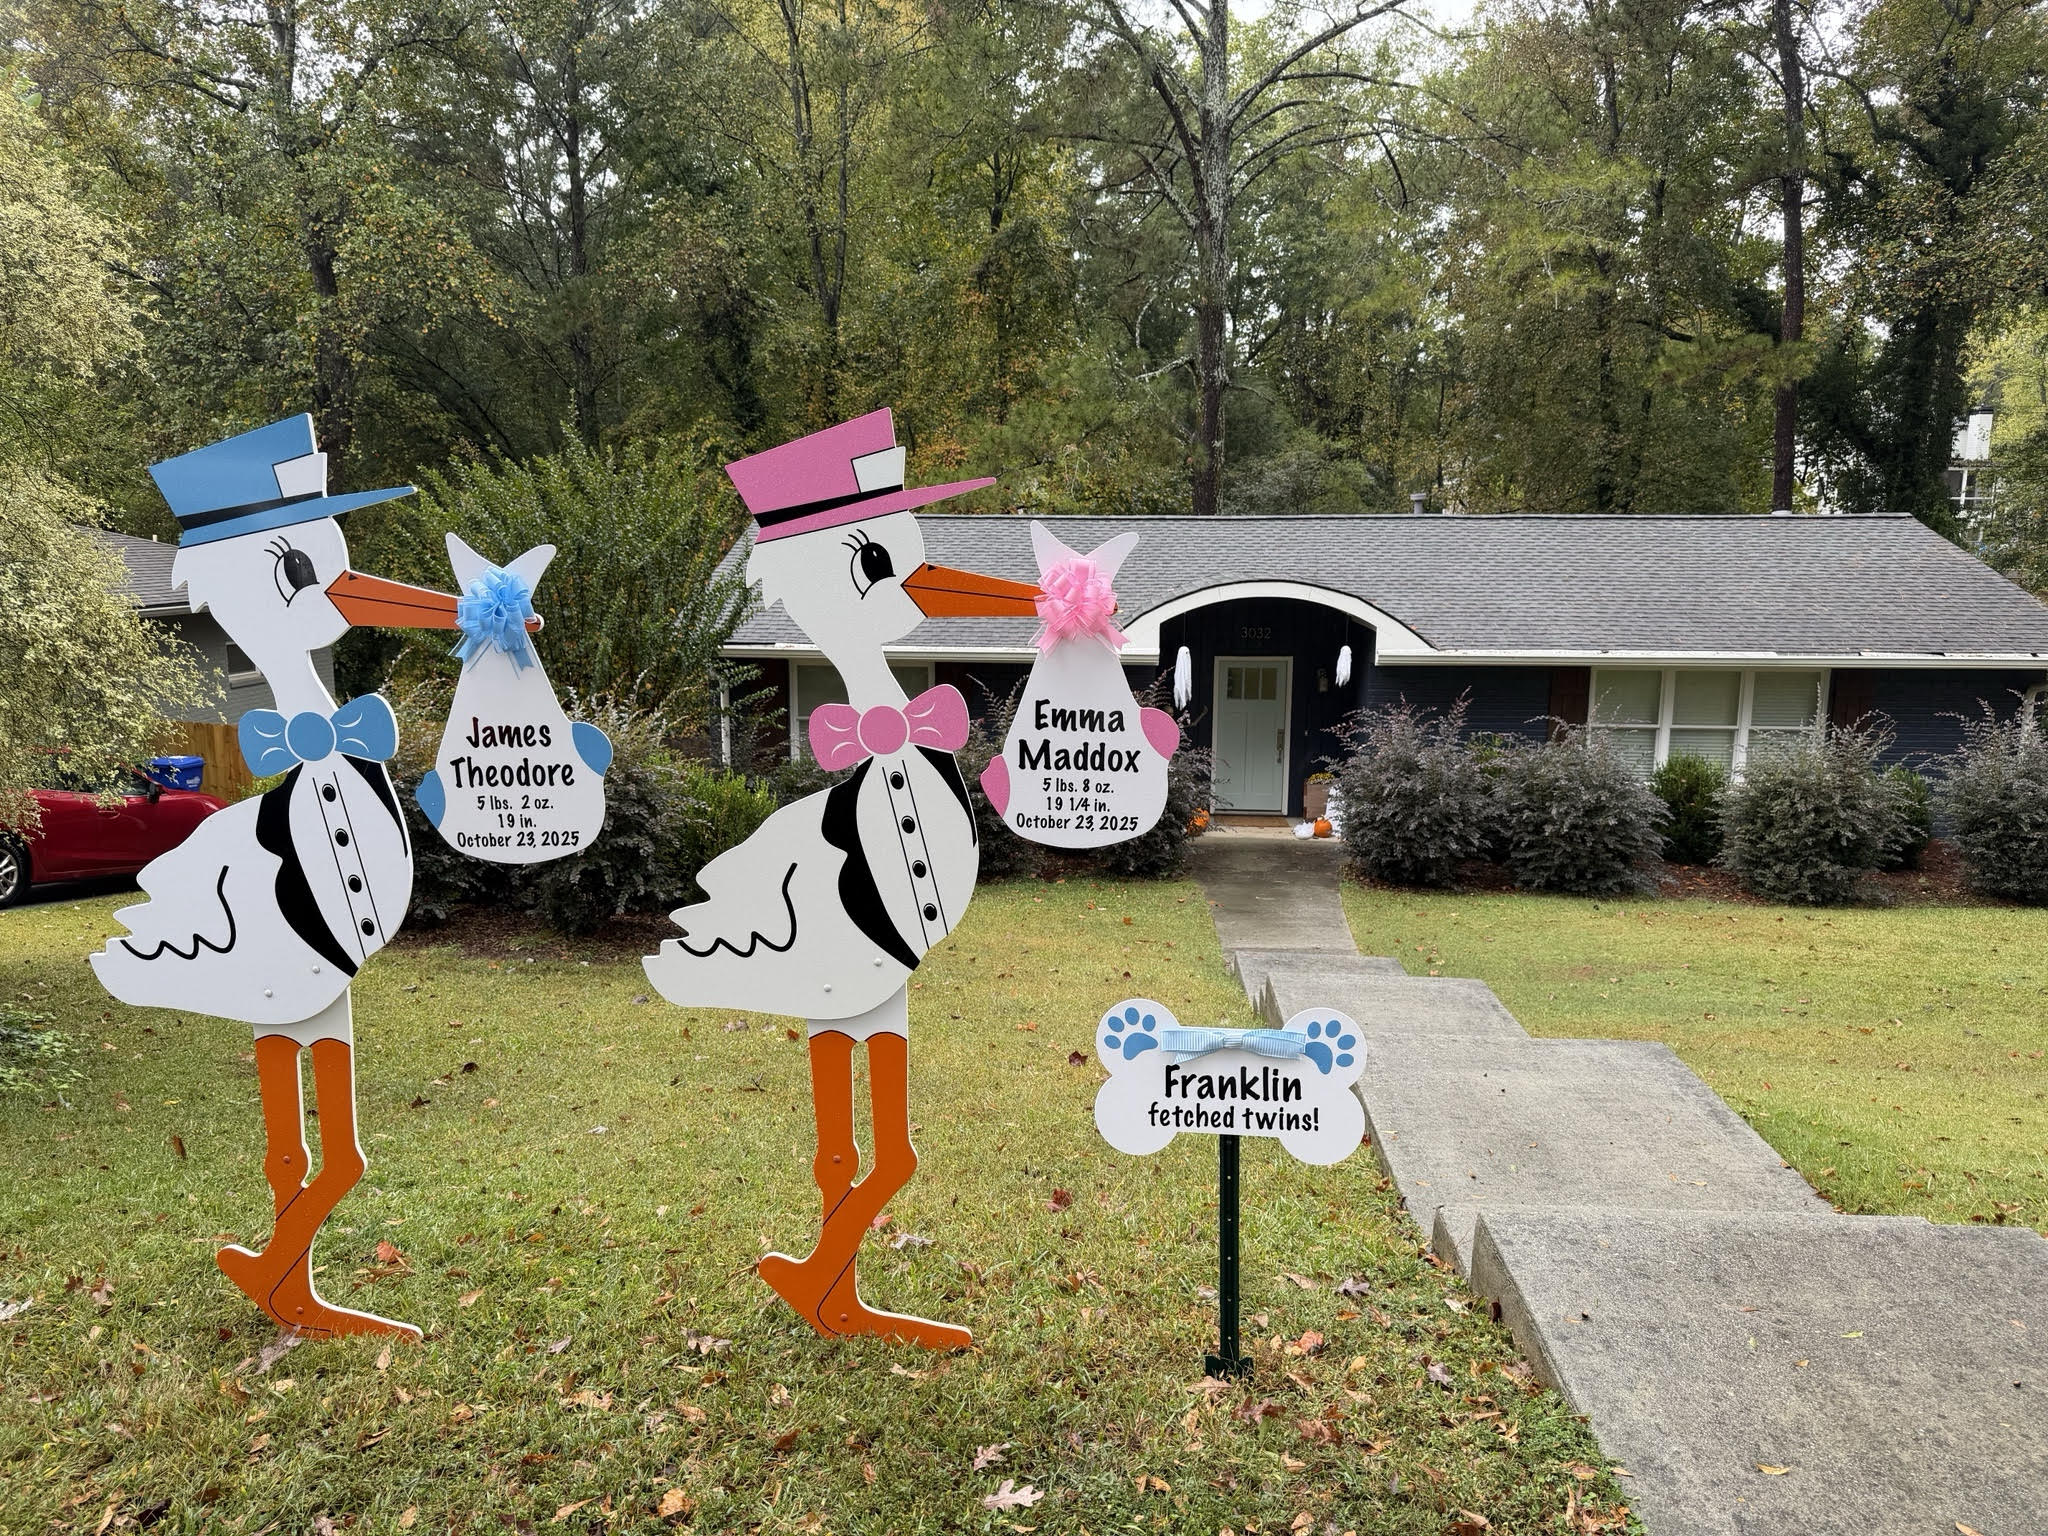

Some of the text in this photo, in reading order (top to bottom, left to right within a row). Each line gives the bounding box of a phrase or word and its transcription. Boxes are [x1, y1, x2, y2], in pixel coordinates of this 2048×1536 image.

[1240, 626, 1272, 640] 3032
[1034, 698, 1126, 733] Emma
[465, 716, 552, 749] James
[1018, 738, 1141, 774] Maddox
[449, 755, 575, 789] Theodore
[1042, 777, 1114, 794] 5 lbs. 8 oz.
[477, 794, 554, 811] 5 lbs. 2 oz.
[1046, 796, 1110, 813] 19 1/4 in.
[497, 813, 537, 829] 19 in.
[1016, 813, 1139, 832] October 23, 2025
[456, 830, 580, 849] October 23, 2025
[1164, 1063, 1302, 1103] Franklin
[1147, 1101, 1319, 1132] fetched twins!
